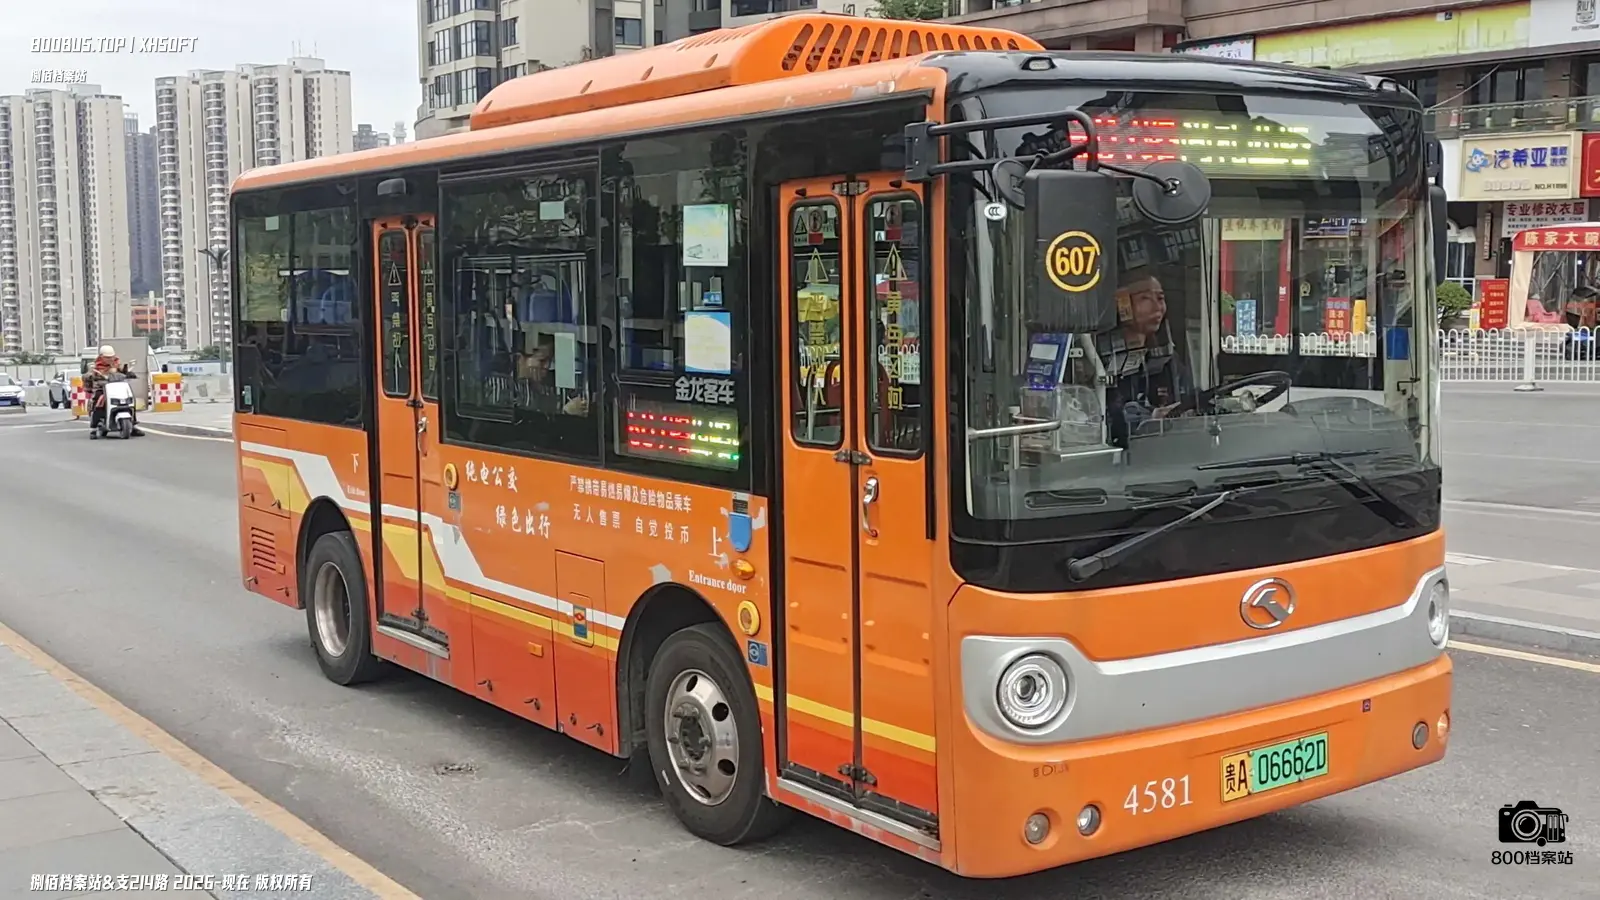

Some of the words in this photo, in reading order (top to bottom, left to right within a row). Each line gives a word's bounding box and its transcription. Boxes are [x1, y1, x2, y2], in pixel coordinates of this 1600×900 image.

[1055, 246, 1096, 276] 607
[675, 376, 735, 404] 金龙客车
[351, 453, 359, 473] 下
[465, 460, 518, 492] 纯电公交
[495, 504, 550, 539] 绿色出行
[573, 503, 620, 529] 无人售票
[635, 516, 689, 544] 自觉投币
[708, 526, 722, 557] 上
[689, 569, 725, 590] Entrance
[1225, 759, 1248, 795] 贵A
[1258, 739, 1326, 785] 06662D
[1124, 775, 1193, 815] 4581
